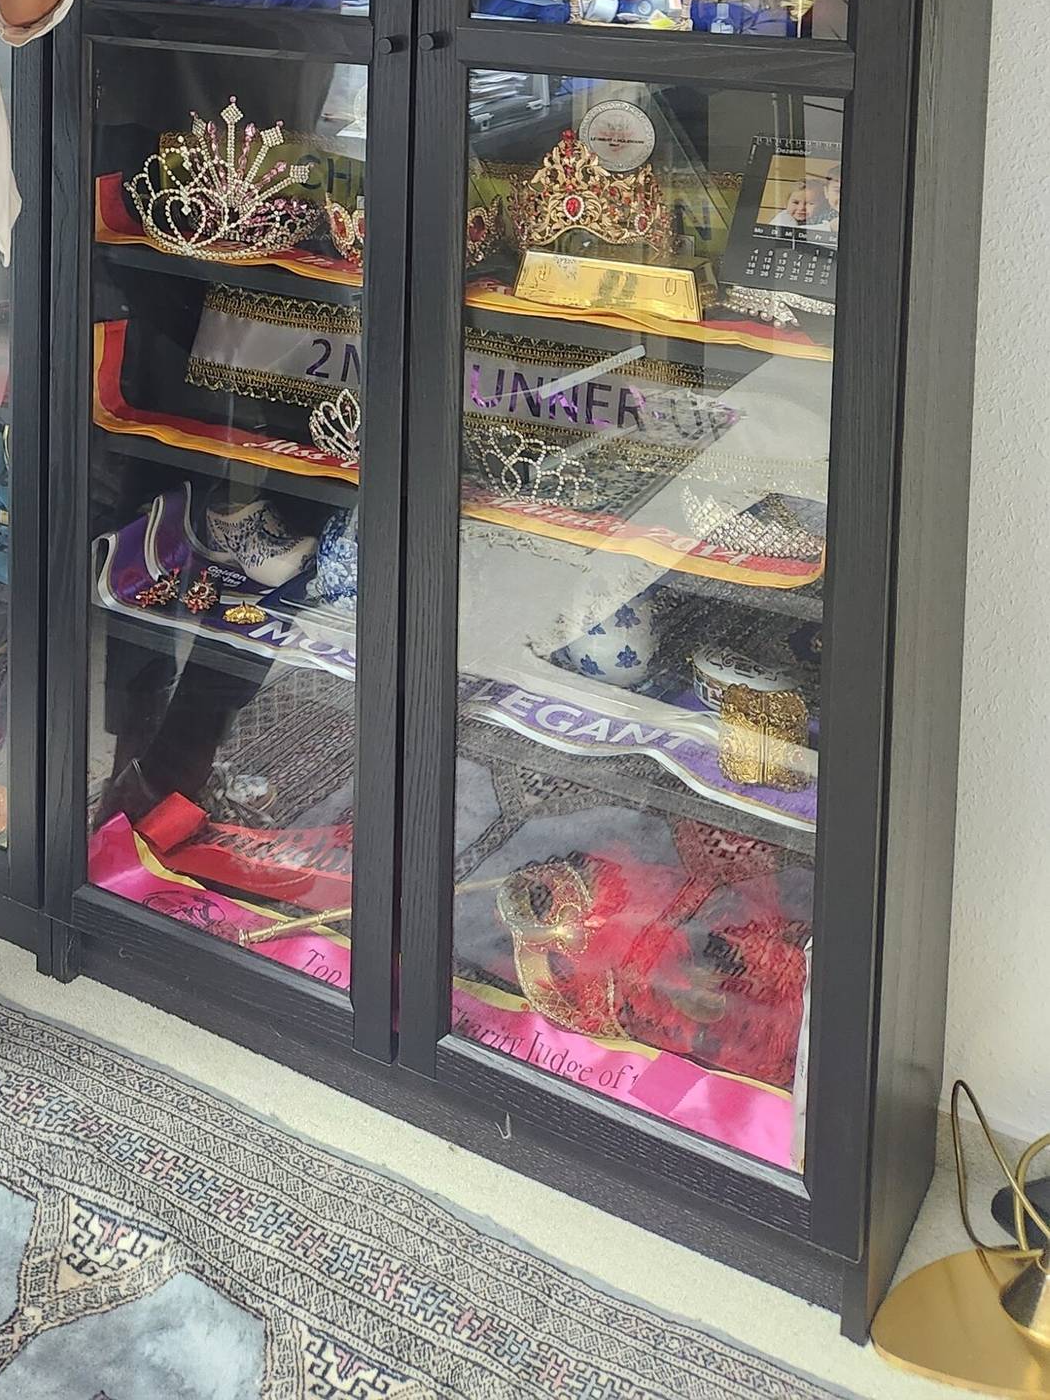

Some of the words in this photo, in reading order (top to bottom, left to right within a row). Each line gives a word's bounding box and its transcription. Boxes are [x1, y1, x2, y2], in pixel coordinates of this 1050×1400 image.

[776, 147, 812, 155] Dezember
[208, 565, 247, 582] Golden
[248, 620, 356, 668] MOS
[467, 680, 706, 751] LEGANT
[598, 1064, 634, 1090] of
